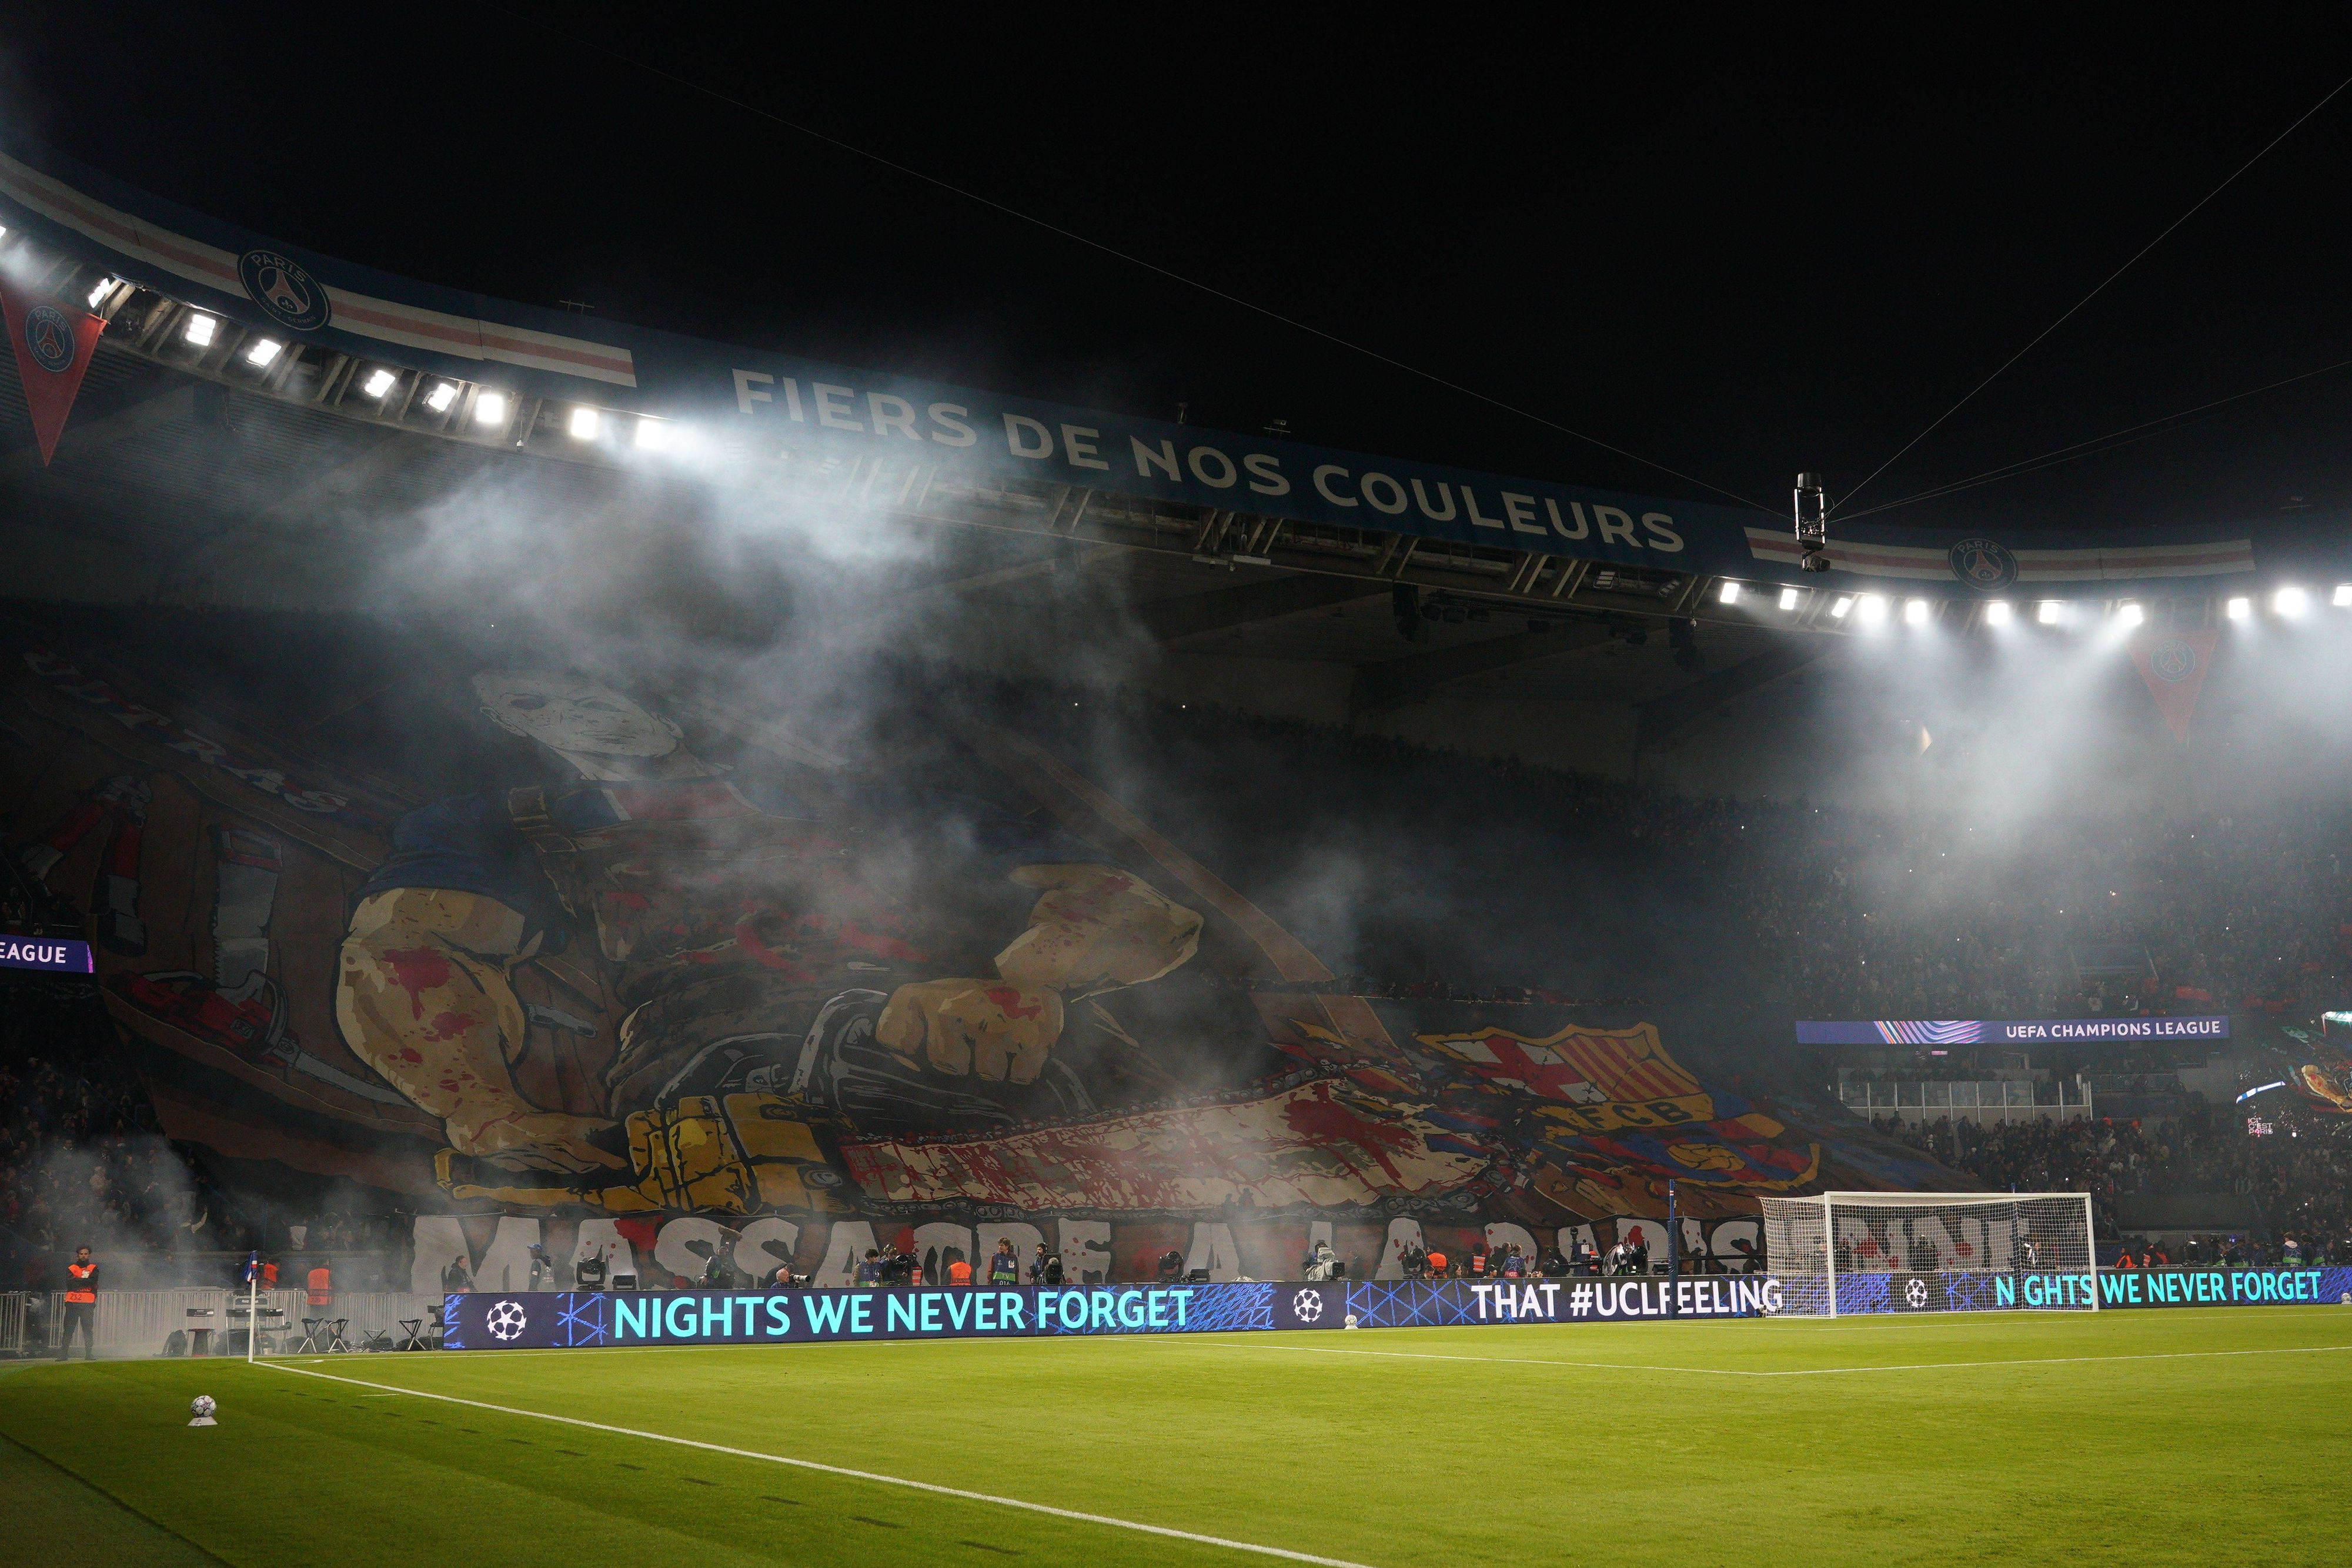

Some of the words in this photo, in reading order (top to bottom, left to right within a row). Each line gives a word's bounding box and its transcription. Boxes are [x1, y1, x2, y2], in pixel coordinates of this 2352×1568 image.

[250, 254, 307, 282] PARIS
[731, 368, 978, 447] FIERS
[1003, 413, 1110, 471] DE
[1130, 434, 1291, 497] NOS
[1312, 464, 1685, 553] COULEURS
[1956, 540, 1999, 554] PARIS
[2006, 1025, 2047, 1038] UEFA
[2050, 1022, 2151, 1038] CHAMPIONS
[2155, 1020, 2221, 1035] LEAGUE
[1576, 1102, 1693, 1128] FCB
[1471, 1283, 1561, 1319] THAT
[1569, 1279, 1783, 1317] #UCLFEELING
[1995, 1275, 2094, 1306] NGHTS
[2099, 1274, 2140, 1303] WE
[2147, 1272, 2227, 1303] NEVER
[2231, 1271, 2322, 1302] FORGET
[614, 1295, 790, 1339] NIGHTS
[803, 1294, 874, 1335] WE
[887, 1292, 1027, 1332] NEVER
[1038, 1289, 1194, 1329] FORGET
